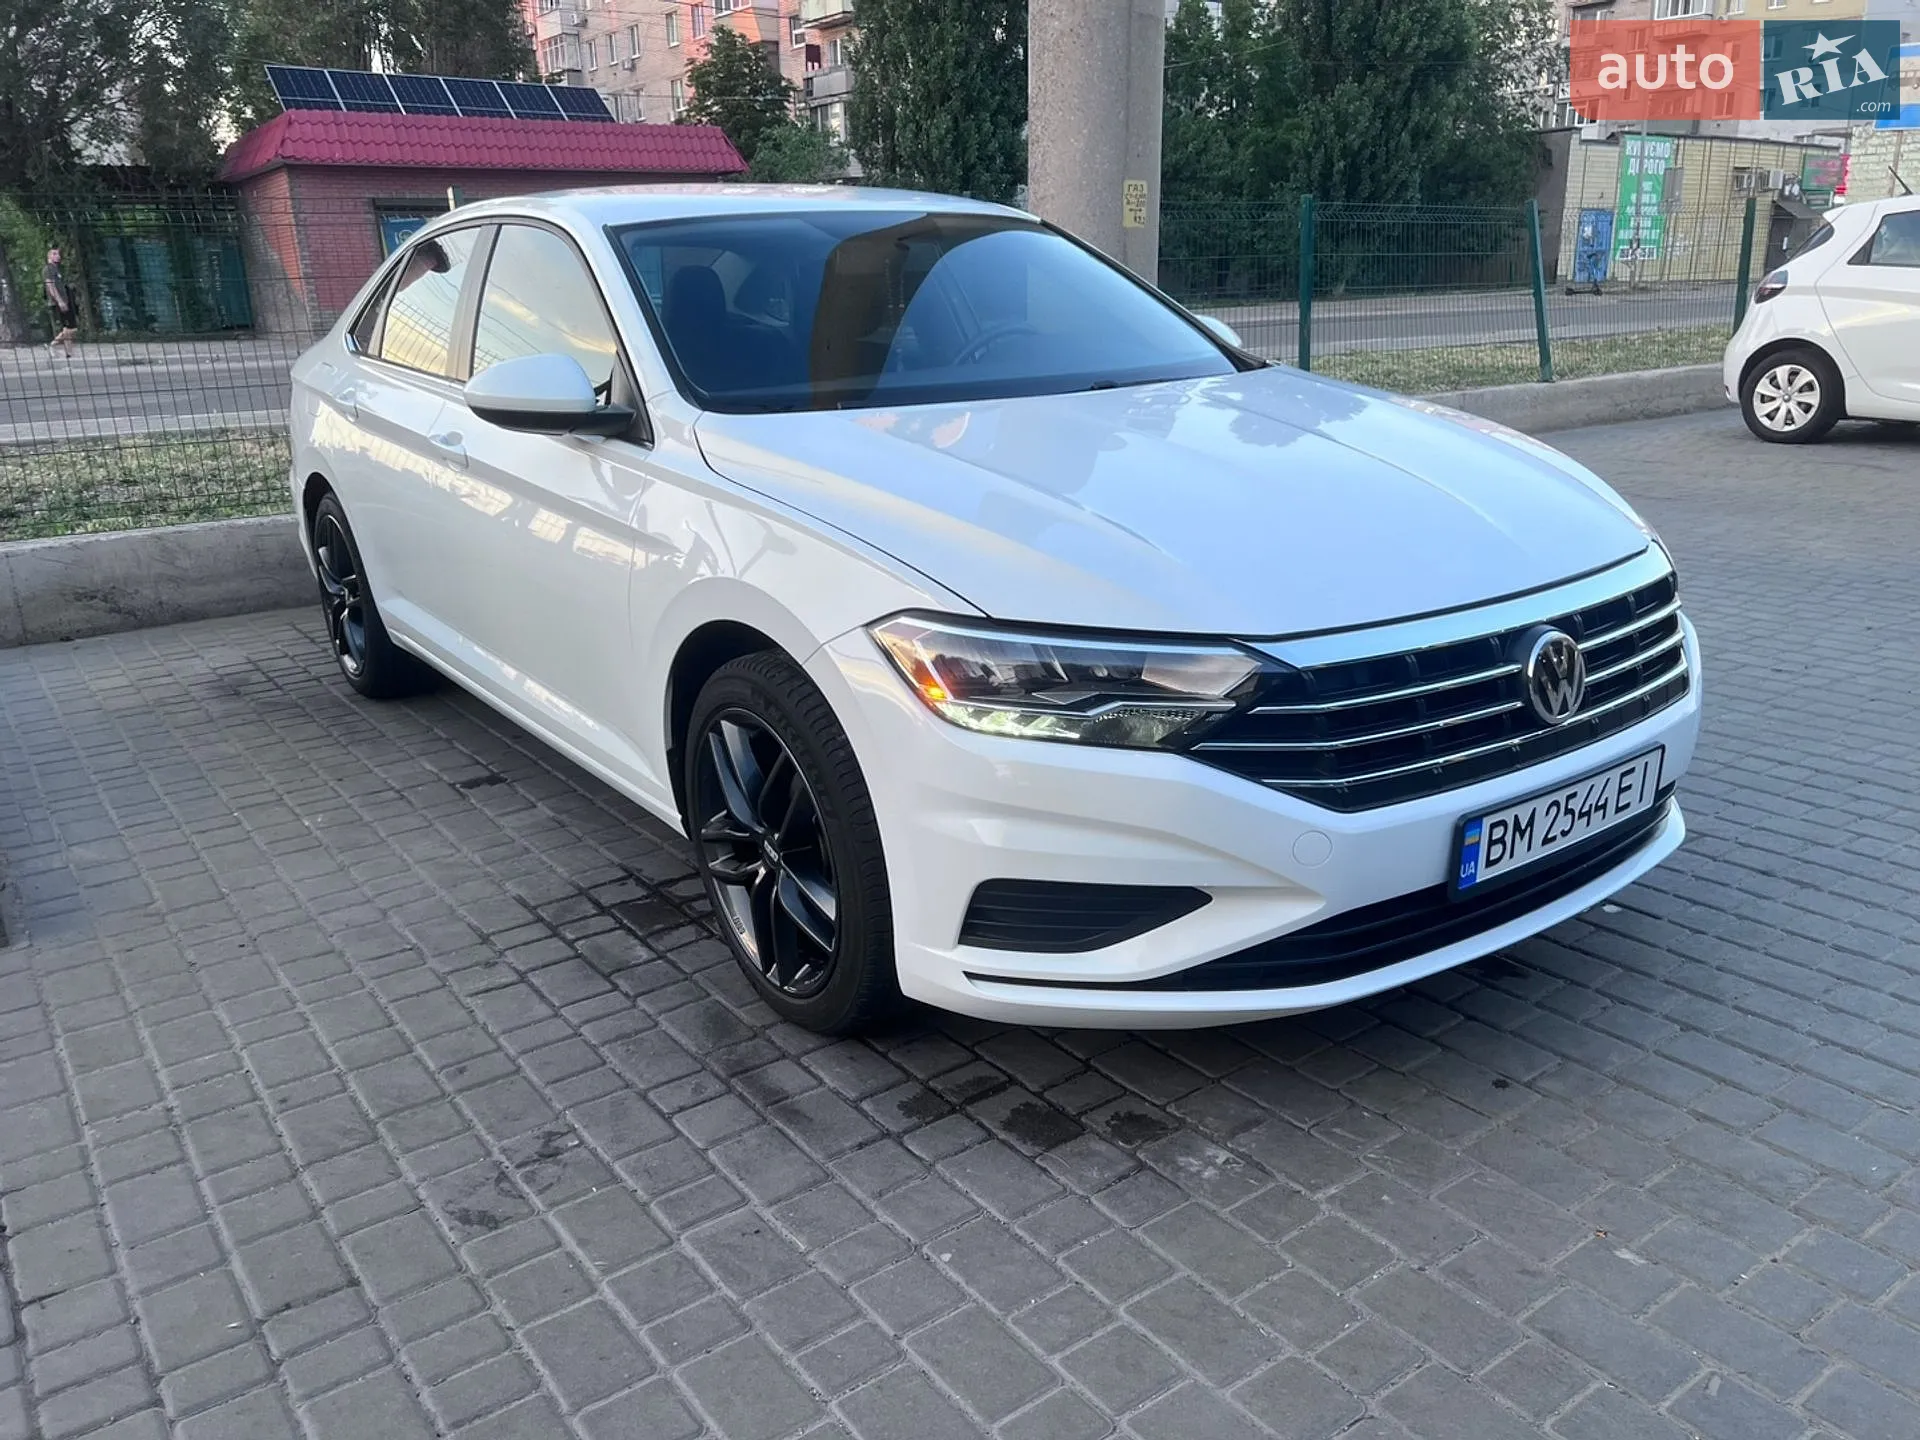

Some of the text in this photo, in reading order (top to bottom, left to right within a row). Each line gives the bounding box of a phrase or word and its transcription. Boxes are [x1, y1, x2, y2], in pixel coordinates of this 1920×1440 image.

[1485, 761, 1650, 869] BM 2544 EI
[1460, 861, 1475, 878] UA
